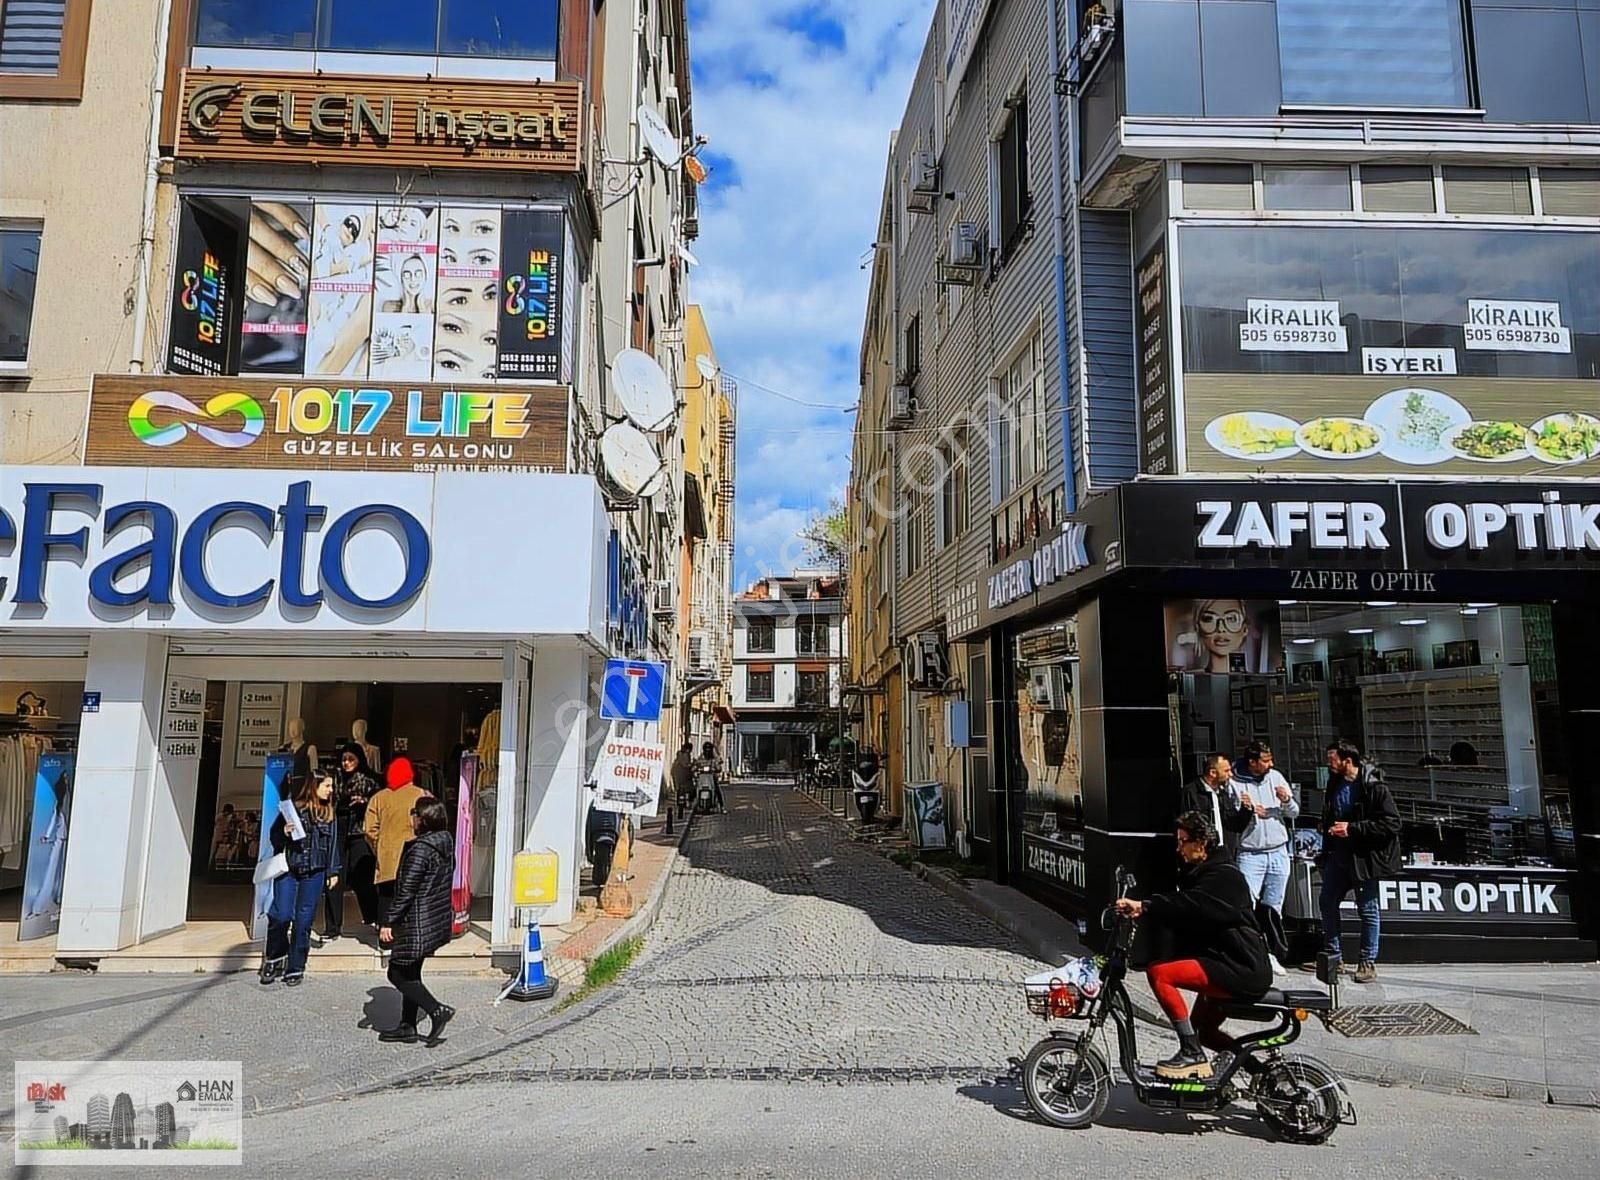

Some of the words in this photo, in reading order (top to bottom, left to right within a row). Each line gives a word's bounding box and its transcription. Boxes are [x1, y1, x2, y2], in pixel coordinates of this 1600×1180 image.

[202, 252, 219, 299] LIFE
[529, 251, 548, 294] LIFE
[198, 300, 215, 344] 1017
[527, 298, 546, 341] 1017
[1250, 304, 1334, 326] KİRALIK
[1471, 304, 1556, 327] KİRALIK
[1241, 329, 1268, 341] 505
[1273, 330, 1337, 343] 6598730
[1466, 329, 1492, 341] 505
[1496, 330, 1560, 344] 6598730
[270, 387, 393, 435] 1017
[405, 391, 532, 438] LIFE
[284, 436, 404, 457] GÜZELLİK
[411, 442, 513, 459] SALONU
[1197, 501, 1390, 550] ZAFER
[1425, 490, 1600, 551] OPTİK
[987, 559, 1032, 609] ZAFER
[1033, 521, 1090, 587] OPTİK
[1290, 571, 1358, 591] ZAFER
[1370, 570, 1437, 592] OPTİK
[607, 743, 663, 761] OTOPARK
[613, 763, 651, 782] GİRİŞİ
[1028, 845, 1057, 877] ZAFER
[1339, 880, 1445, 912] FER
[1454, 876, 1559, 914] OPTİK
